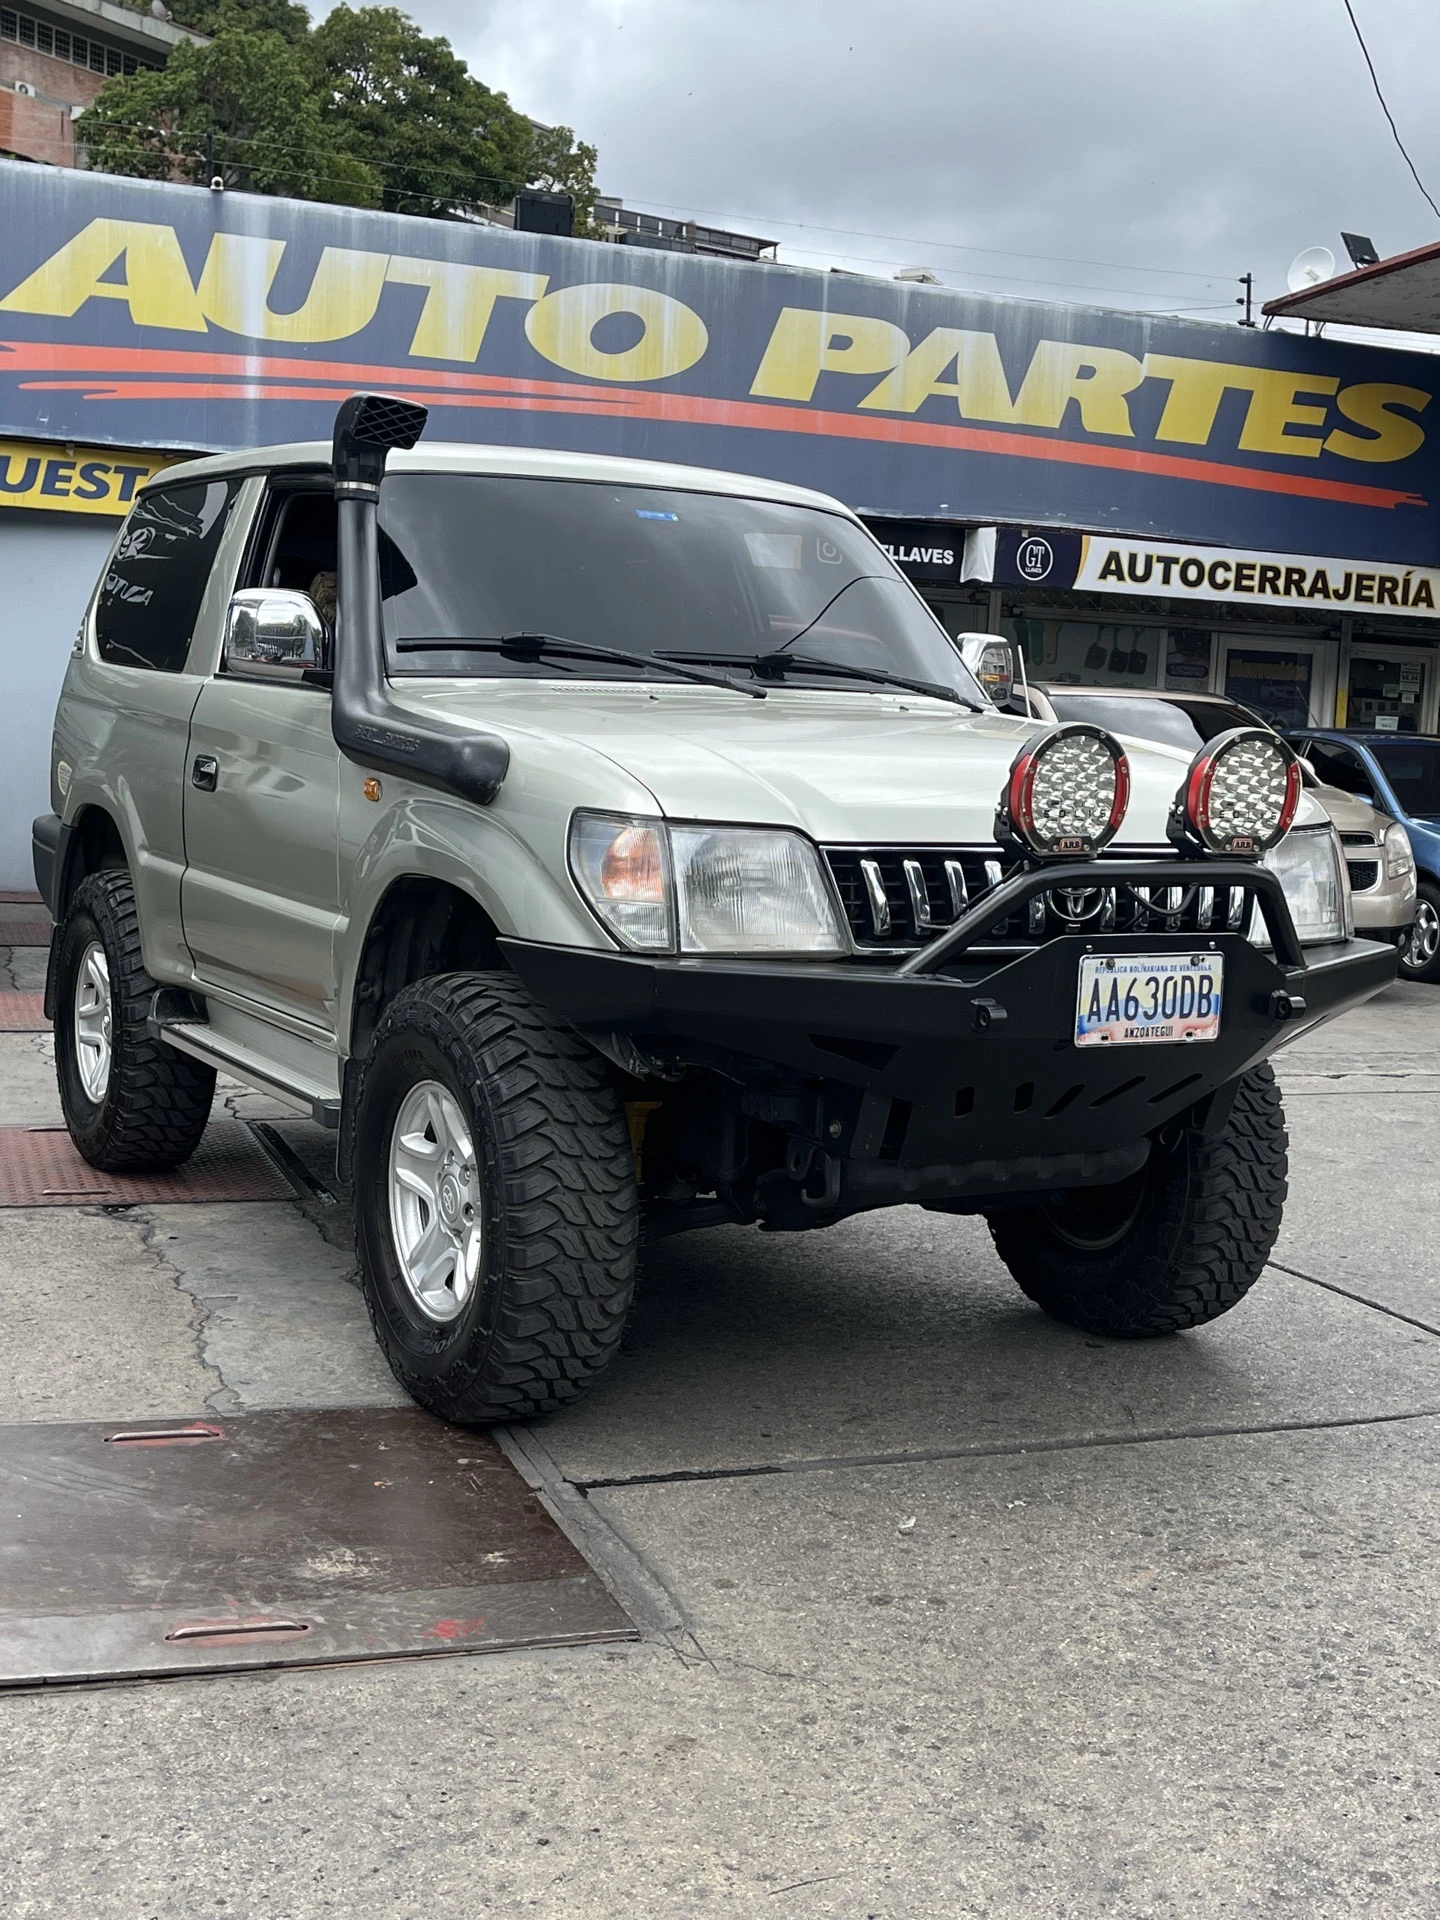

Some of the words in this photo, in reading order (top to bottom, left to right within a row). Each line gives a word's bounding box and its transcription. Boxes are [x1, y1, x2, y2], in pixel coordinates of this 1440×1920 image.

[0, 217, 709, 382] AUTO
[749, 307, 1432, 463] PARTES
[1026, 544, 1045, 567] GT
[1098, 550, 1436, 610] AUTOCERRAJERÍA
[1063, 841, 1080, 849] ARB
[1235, 841, 1251, 849] ARB
[1170, 964, 1178, 972] DE
[1180, 964, 1212, 972] VENEZUELA
[1087, 975, 1213, 1023] AA630DB
[1124, 1026, 1173, 1038] ANZOATEGUI
